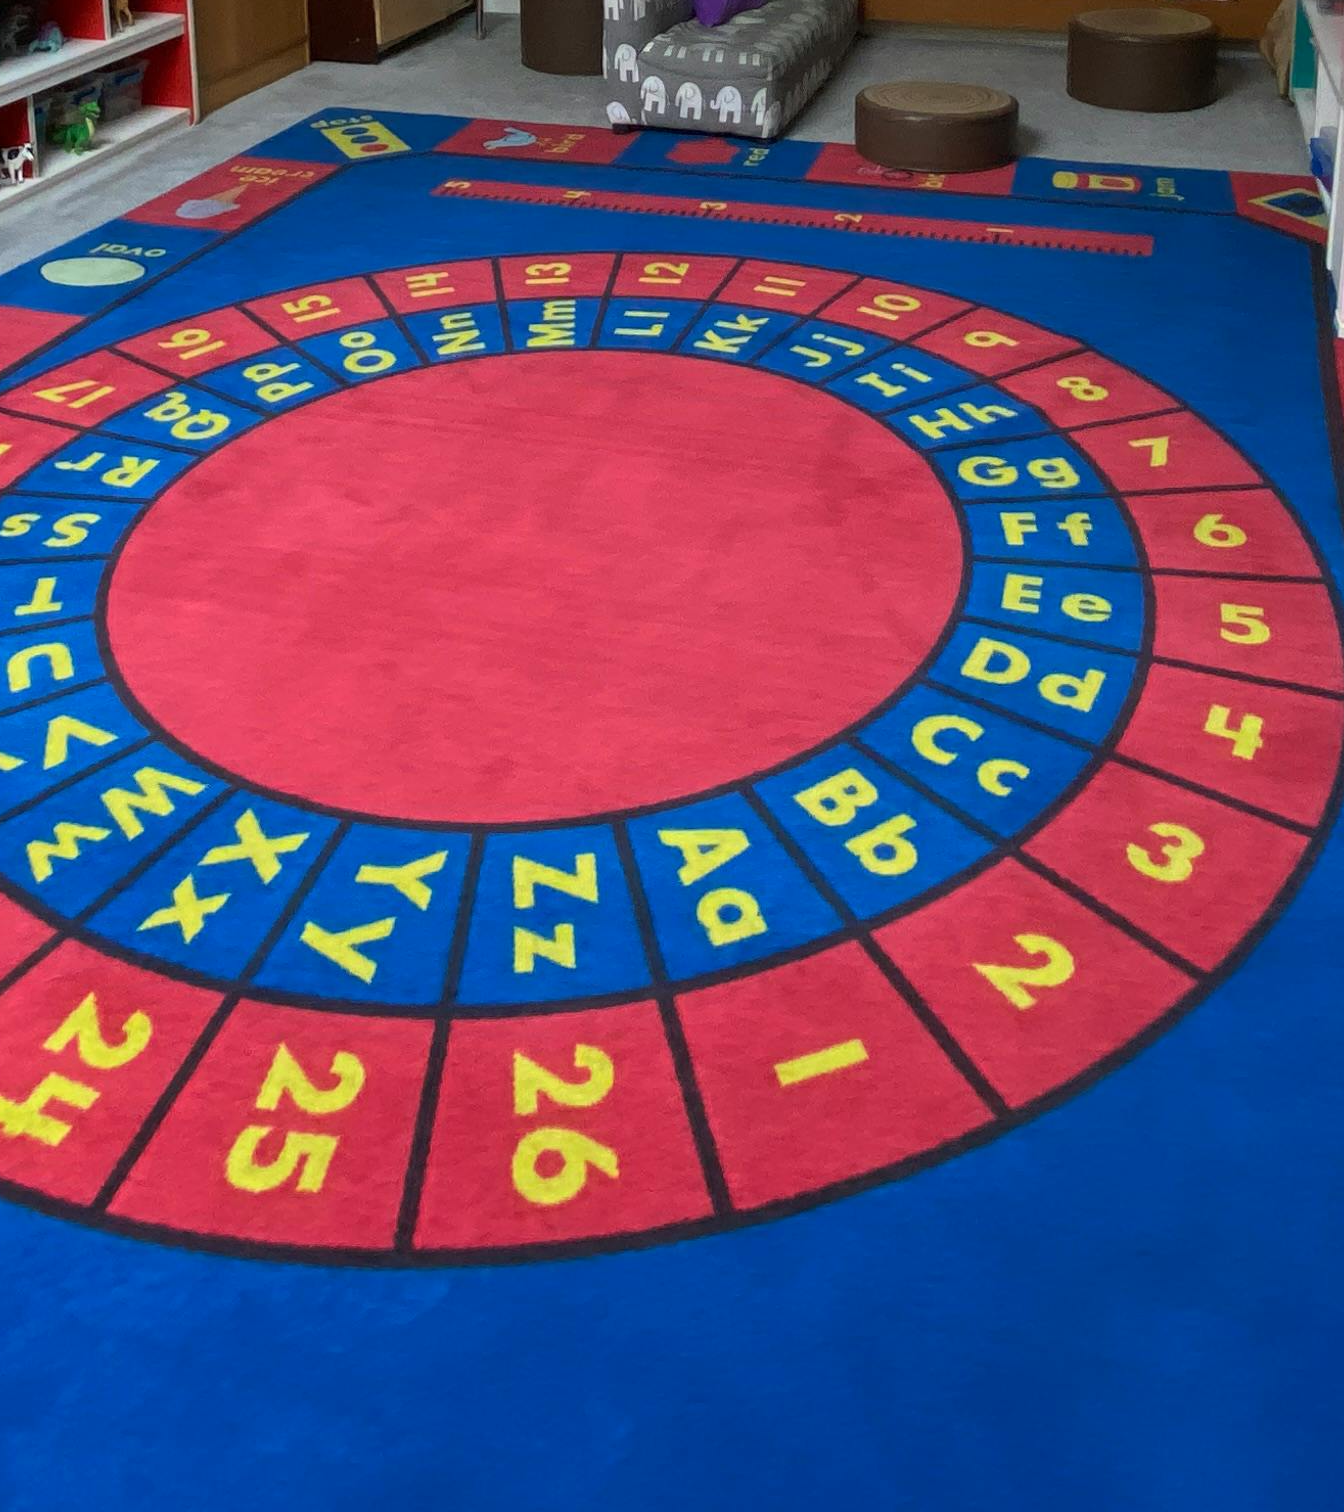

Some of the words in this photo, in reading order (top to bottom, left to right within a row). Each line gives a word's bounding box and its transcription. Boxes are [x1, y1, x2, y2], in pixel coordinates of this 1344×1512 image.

[310, 114, 373, 129] stop
[742, 147, 771, 167] red
[228, 165, 316, 178] cream
[256, 175, 281, 186] ice
[700, 201, 727, 212] 3
[834, 212, 863, 224] 2
[90, 241, 168, 260] oval
[409, 271, 455, 297] 14
[524, 262, 572, 285] 13
[638, 261, 690, 285] 12
[754, 275, 807, 297] 11
[282, 294, 342, 323] 15
[857, 293, 921, 320] 10
[158, 329, 227, 360] 16
[965, 330, 1021, 348] 9
[34, 383, 118, 408] 17
[1058, 375, 1109, 403] 8
[1132, 435, 1170, 468] 7
[1192, 512, 1247, 549] 6
[1219, 602, 1272, 646] 5
[1203, 704, 1264, 761] 4
[1125, 821, 1206, 884] 3
[974, 933, 1075, 1010] 2
[774, 1038, 869, 1087] 1
[225, 1044, 366, 1194] 25
[510, 1043, 620, 1206] 26
